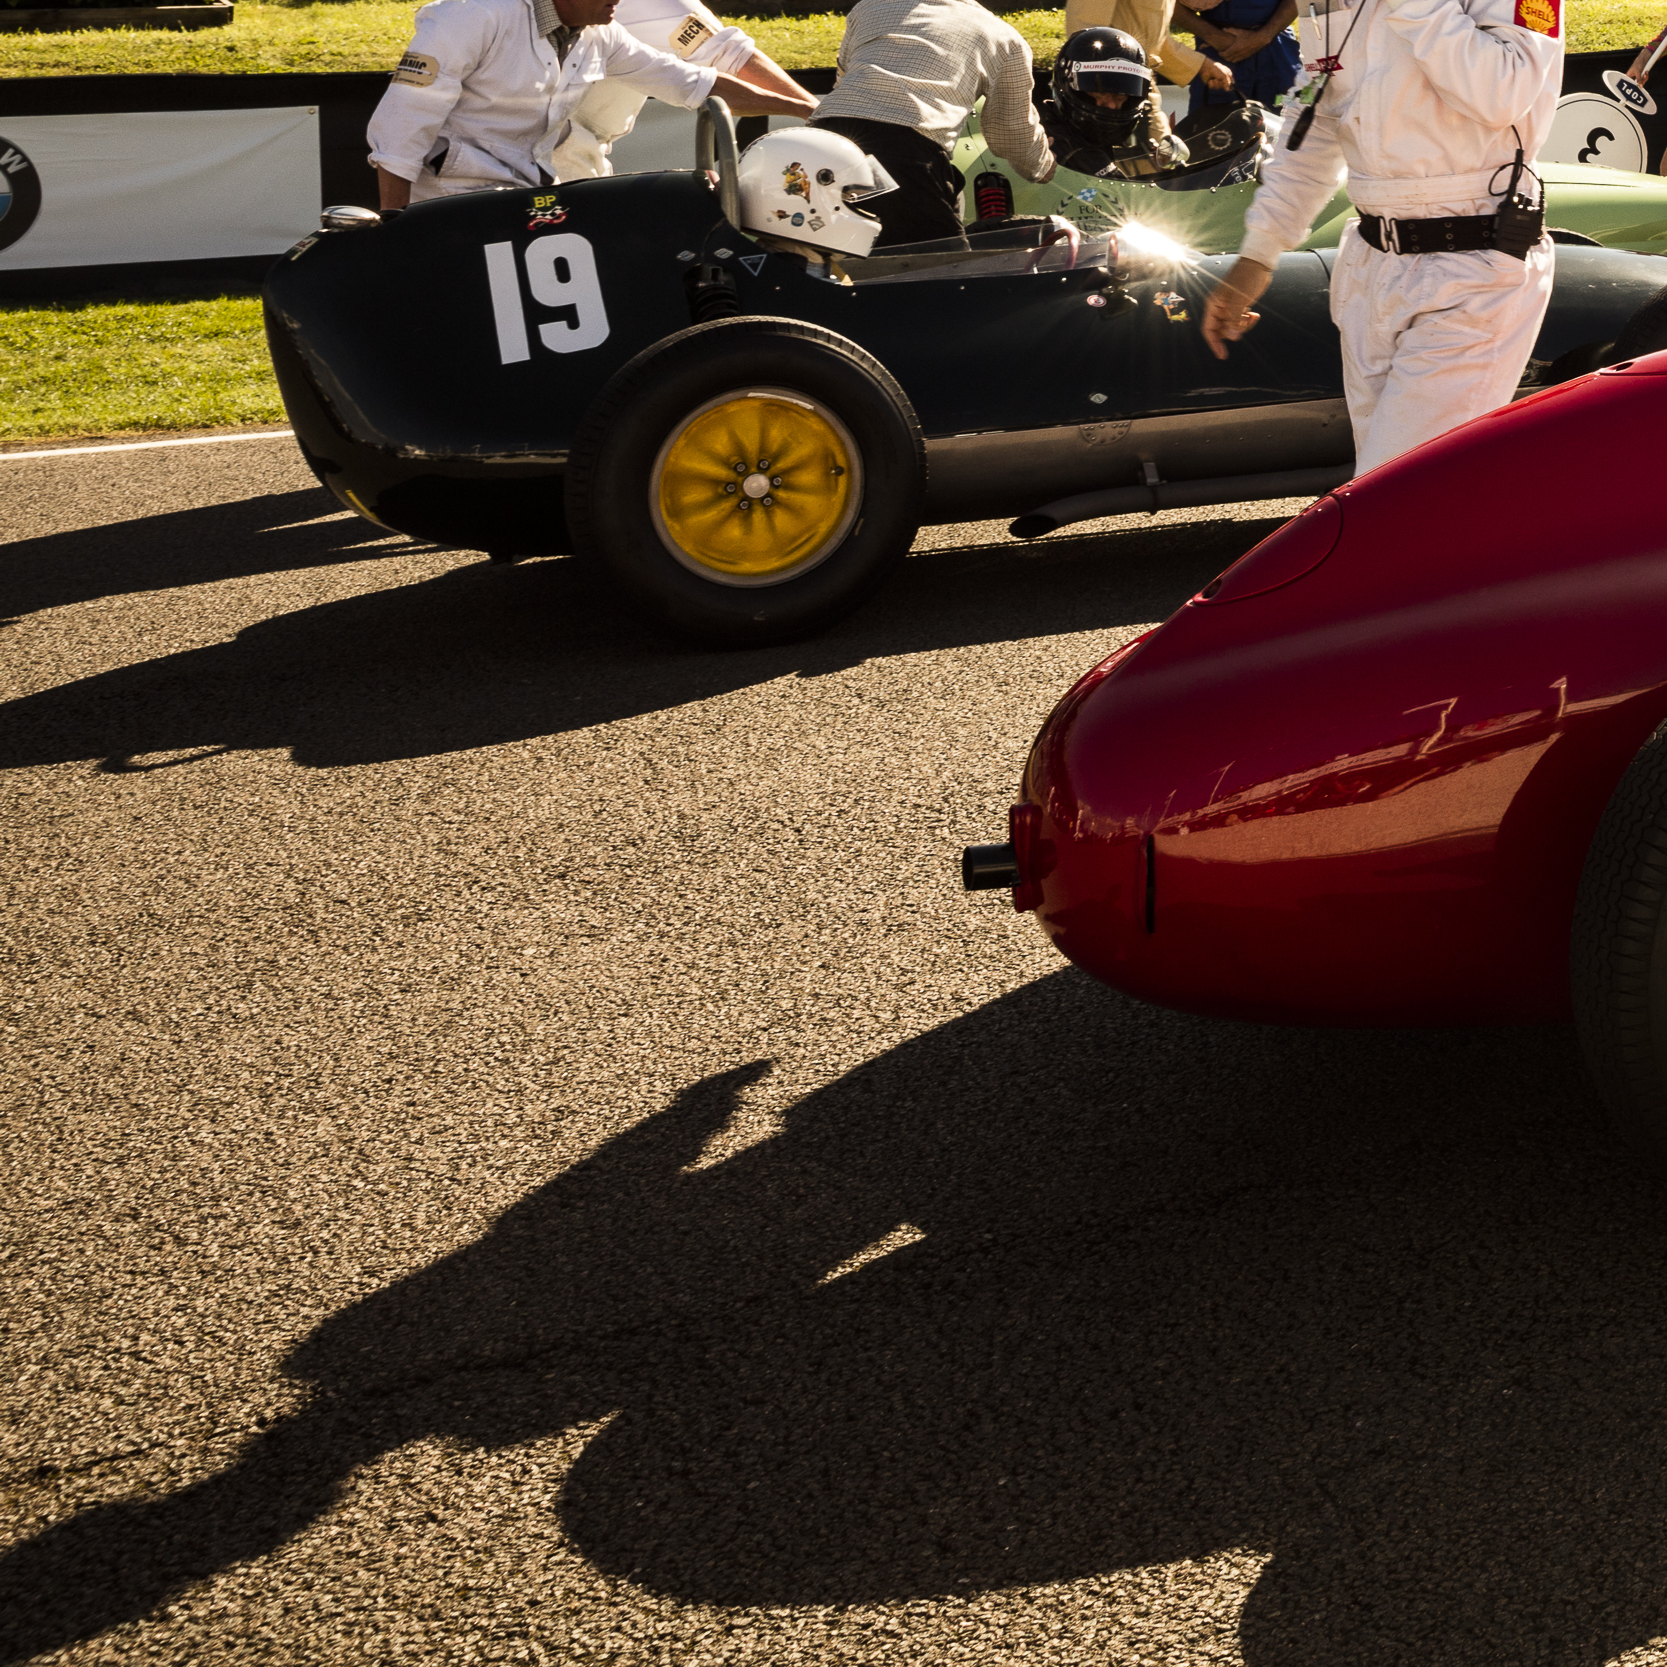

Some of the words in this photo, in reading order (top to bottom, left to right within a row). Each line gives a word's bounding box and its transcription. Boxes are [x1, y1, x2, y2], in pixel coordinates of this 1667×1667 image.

[1525, 6, 1551, 23] SHELL
[677, 19, 705, 47] MECH
[1622, 82, 1645, 104] COPL
[533, 195, 556, 208] BP
[484, 233, 611, 365] 19
